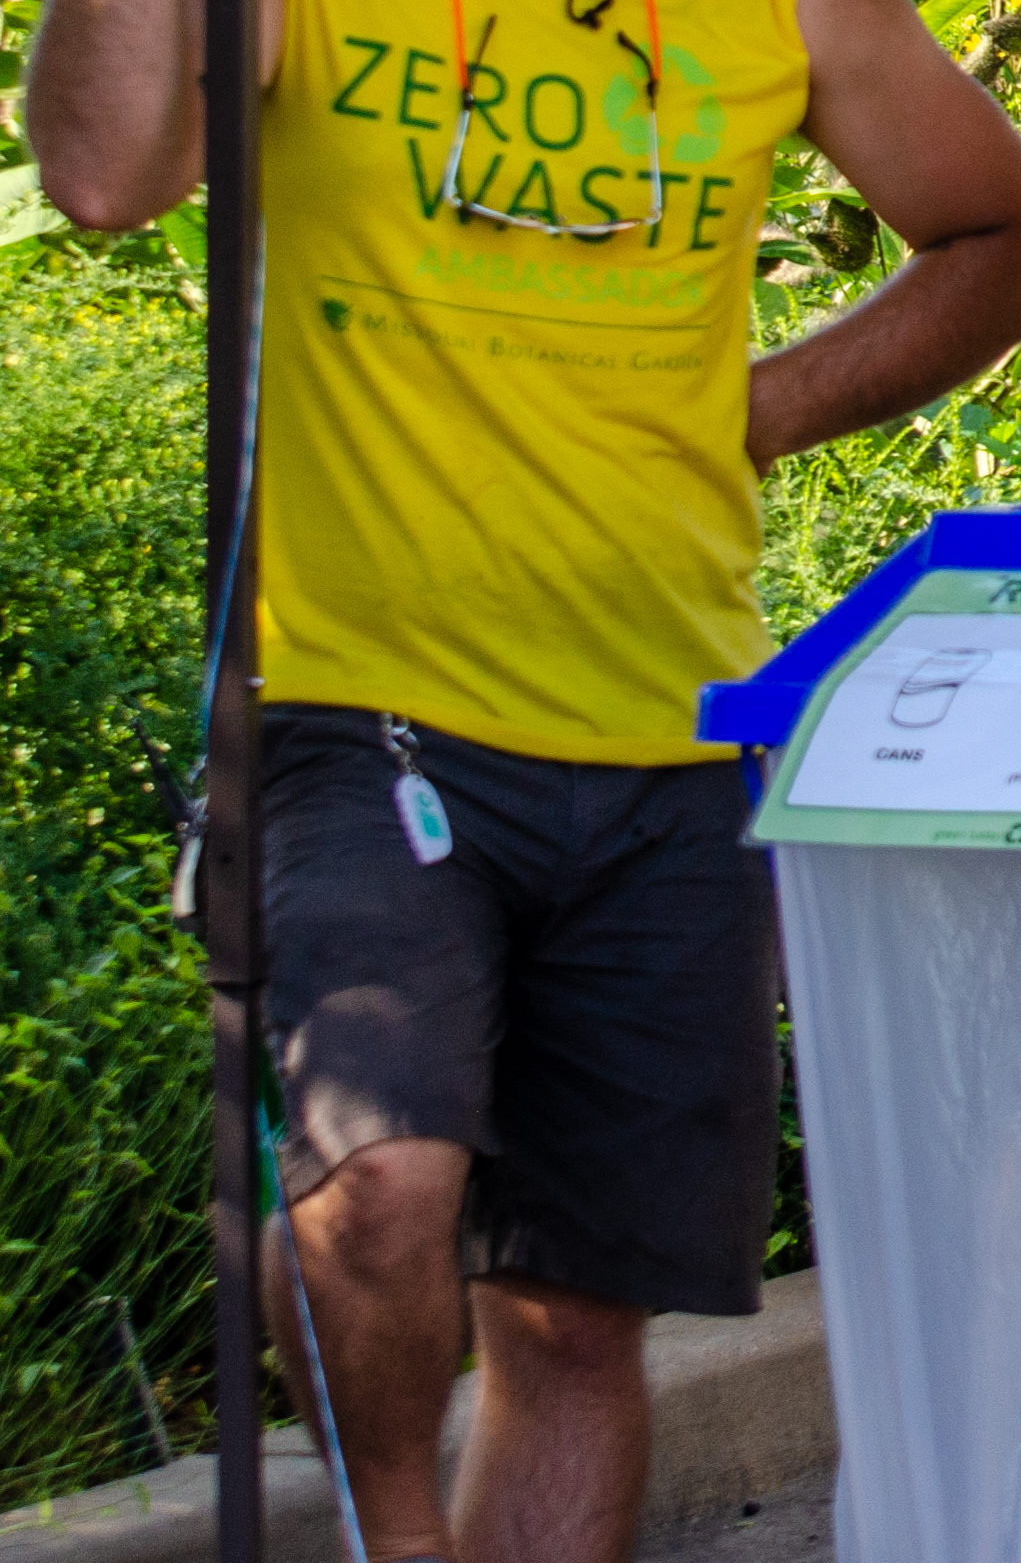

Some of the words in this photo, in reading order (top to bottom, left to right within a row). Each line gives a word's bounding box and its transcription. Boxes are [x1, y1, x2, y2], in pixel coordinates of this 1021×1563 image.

[331, 35, 586, 152] ZERO
[406, 138, 733, 251] WASTE
[874, 746, 926, 763] CANS
